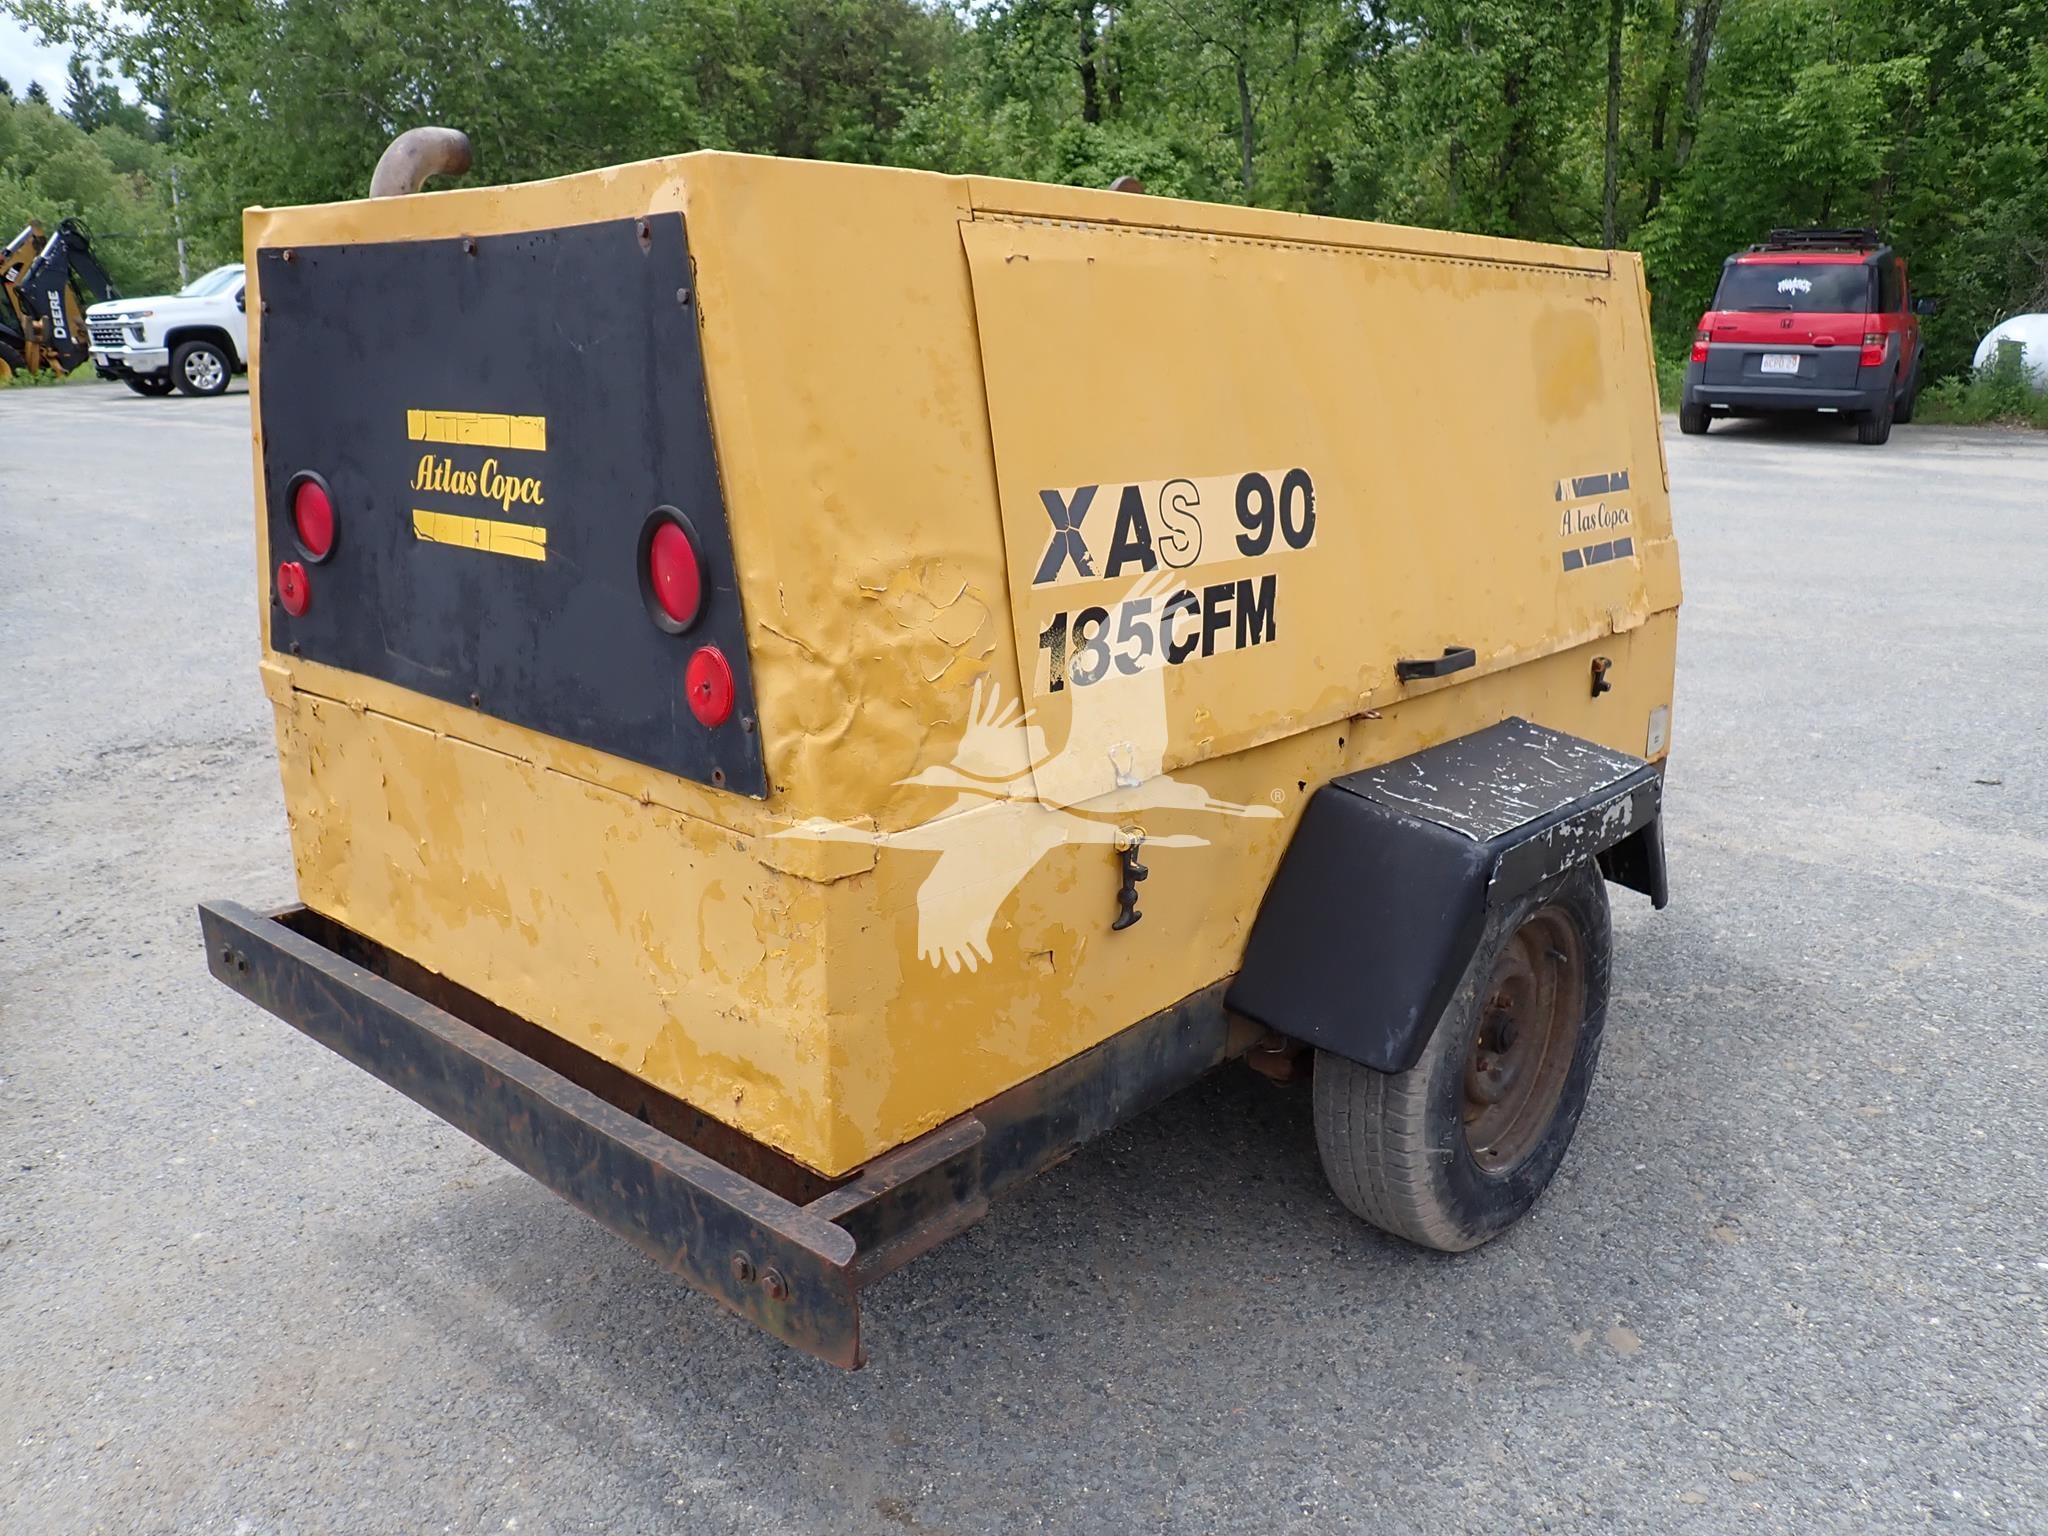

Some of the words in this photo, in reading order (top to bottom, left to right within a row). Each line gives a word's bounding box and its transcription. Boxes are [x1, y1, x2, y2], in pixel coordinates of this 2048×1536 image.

[47, 290, 67, 338] DEERE
[410, 454, 477, 496] Atlas
[1032, 478, 1203, 585] XAS
[1235, 467, 1317, 557] 90
[1560, 509, 1597, 536] Alas
[1038, 573, 1278, 693] 185CFM
